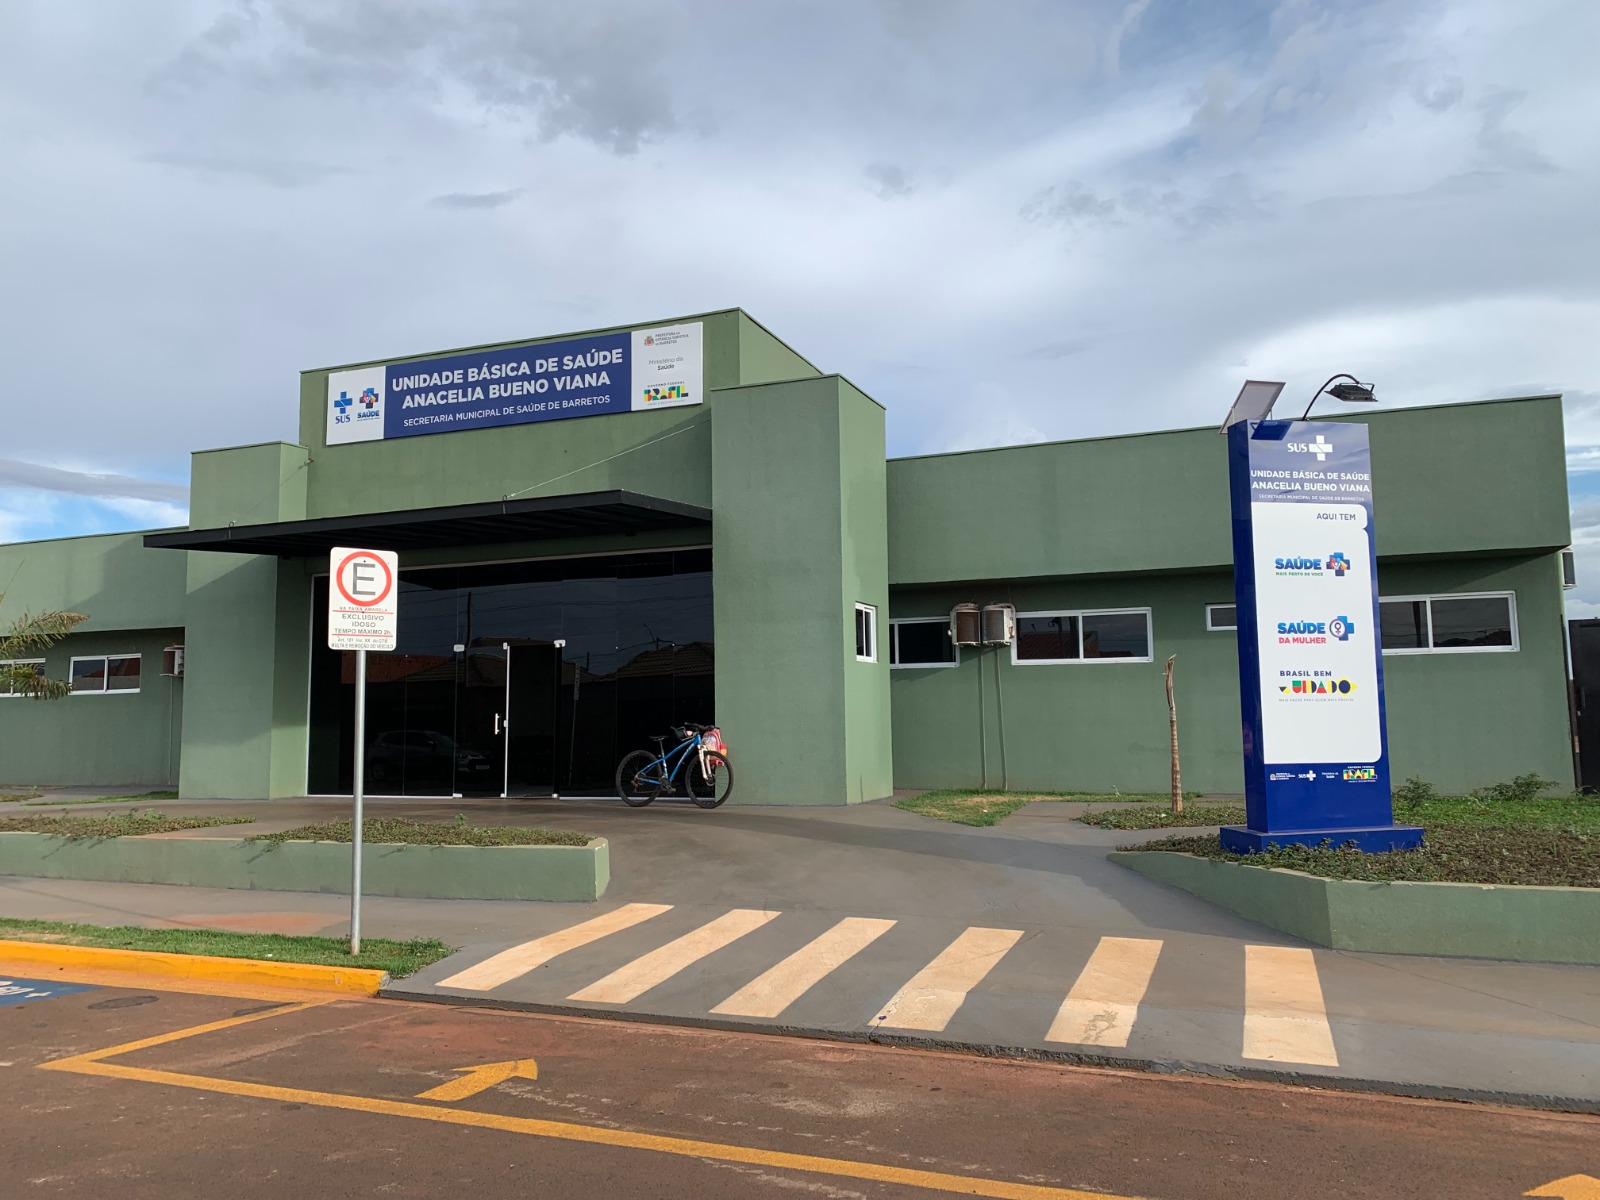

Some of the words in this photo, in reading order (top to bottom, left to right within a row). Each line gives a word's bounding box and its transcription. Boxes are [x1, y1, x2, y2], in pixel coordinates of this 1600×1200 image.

[392, 370, 464, 391] UNIDADE
[468, 362, 531, 382] BÁSICA
[535, 357, 558, 373] DE
[562, 348, 623, 370] SAÚDE
[402, 386, 485, 409] ANACELIA
[489, 379, 549, 398] BUENO
[553, 371, 611, 391] VIANA
[643, 385, 689, 402] BRASIL
[357, 409, 380, 419] SAÚDE
[403, 413, 454, 427] SECRETARIA
[455, 408, 501, 421] MUNICIPAL
[503, 406, 515, 415] DE
[516, 402, 546, 414] SAÚDE
[548, 400, 560, 410] DE
[562, 394, 611, 408] BARRETOS
[335, 414, 351, 424] SUS
[1287, 442, 1308, 452] SUS
[1250, 469, 1293, 479] UNIDADE
[1292, 469, 1325, 479] BÁSICA
[1327, 472, 1339, 480] DE
[1340, 471, 1370, 481] SAÚDE
[1252, 481, 1302, 490] ANACELIA
[1304, 482, 1337, 491] BUENO
[1339, 483, 1371, 493] VIANA
[1275, 556, 1322, 570] SAÚDE
[352, 562, 376, 596] E
[1277, 620, 1326, 634] SAÚDE
